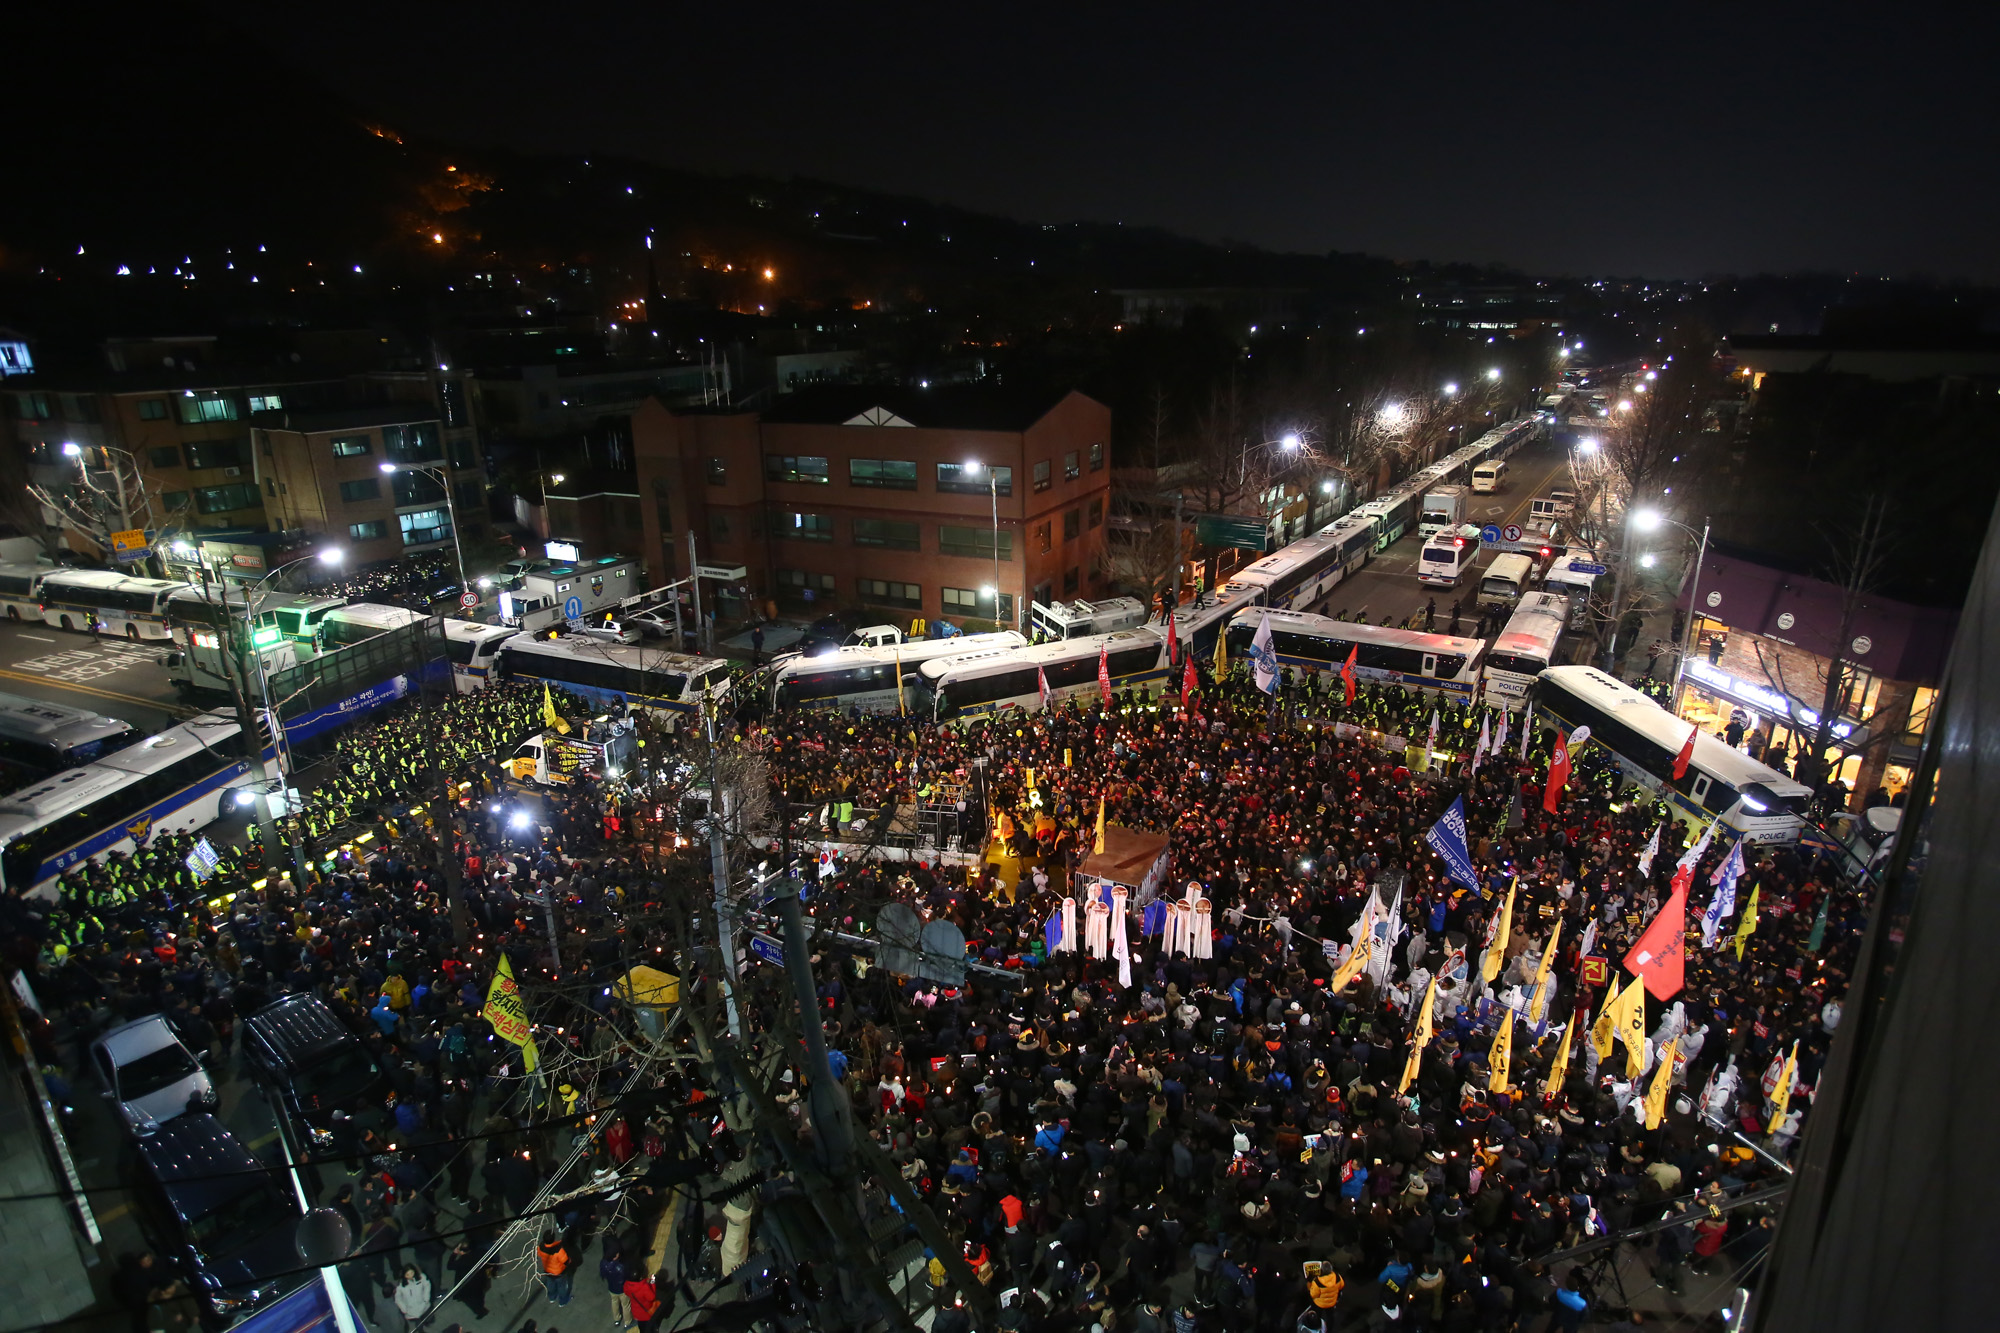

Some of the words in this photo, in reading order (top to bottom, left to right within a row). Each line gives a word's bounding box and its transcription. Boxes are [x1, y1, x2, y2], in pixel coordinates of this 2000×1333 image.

[464, 596, 476, 604] 50
[282, 634, 299, 642] POLICE
[1440, 681, 1463, 691] POLICE
[1498, 682, 1525, 693] POLICE
[339, 697, 358, 711] 폴리스
[359, 689, 375, 700] 라인!
[1758, 831, 1787, 841] POLICE
[1432, 839, 1480, 892] 전국금속노동조합
